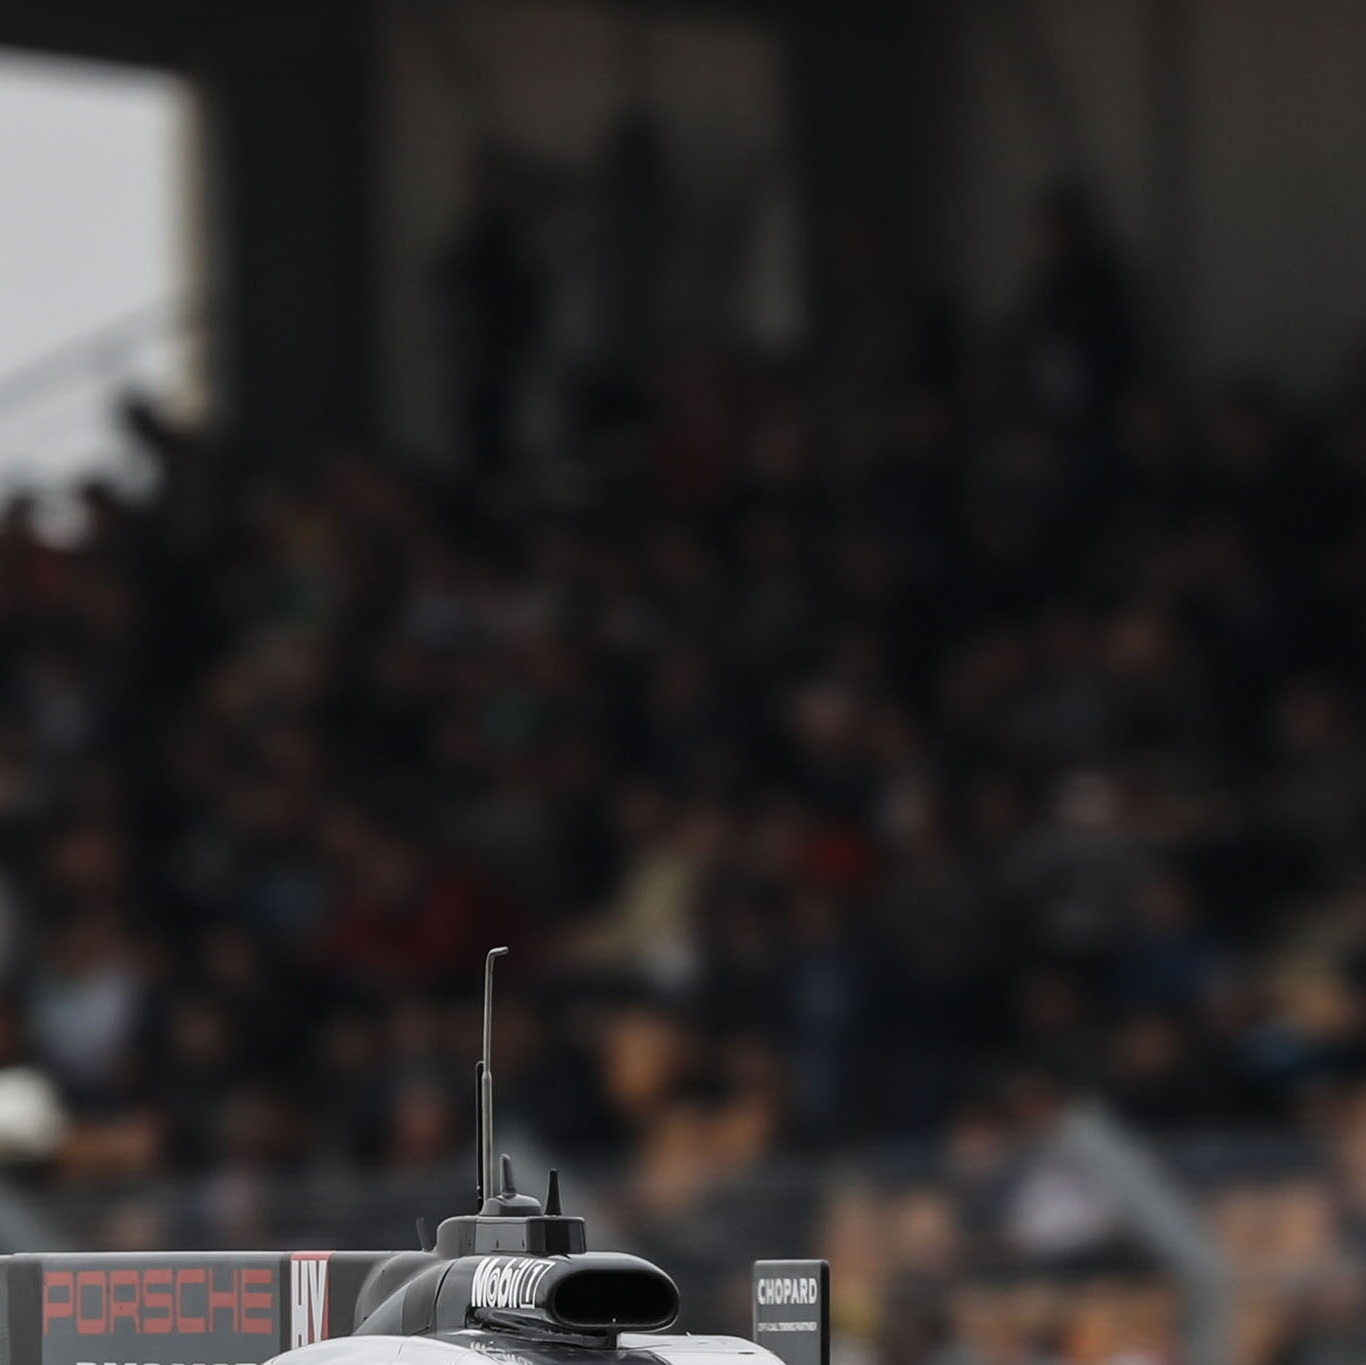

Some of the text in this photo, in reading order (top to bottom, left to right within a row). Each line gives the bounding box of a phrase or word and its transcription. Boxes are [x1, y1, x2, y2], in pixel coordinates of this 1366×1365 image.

[43, 1269, 274, 1335] PORSCHE
[471, 1258, 535, 1308] Mobil
[758, 1278, 817, 1304] CHOPARD
